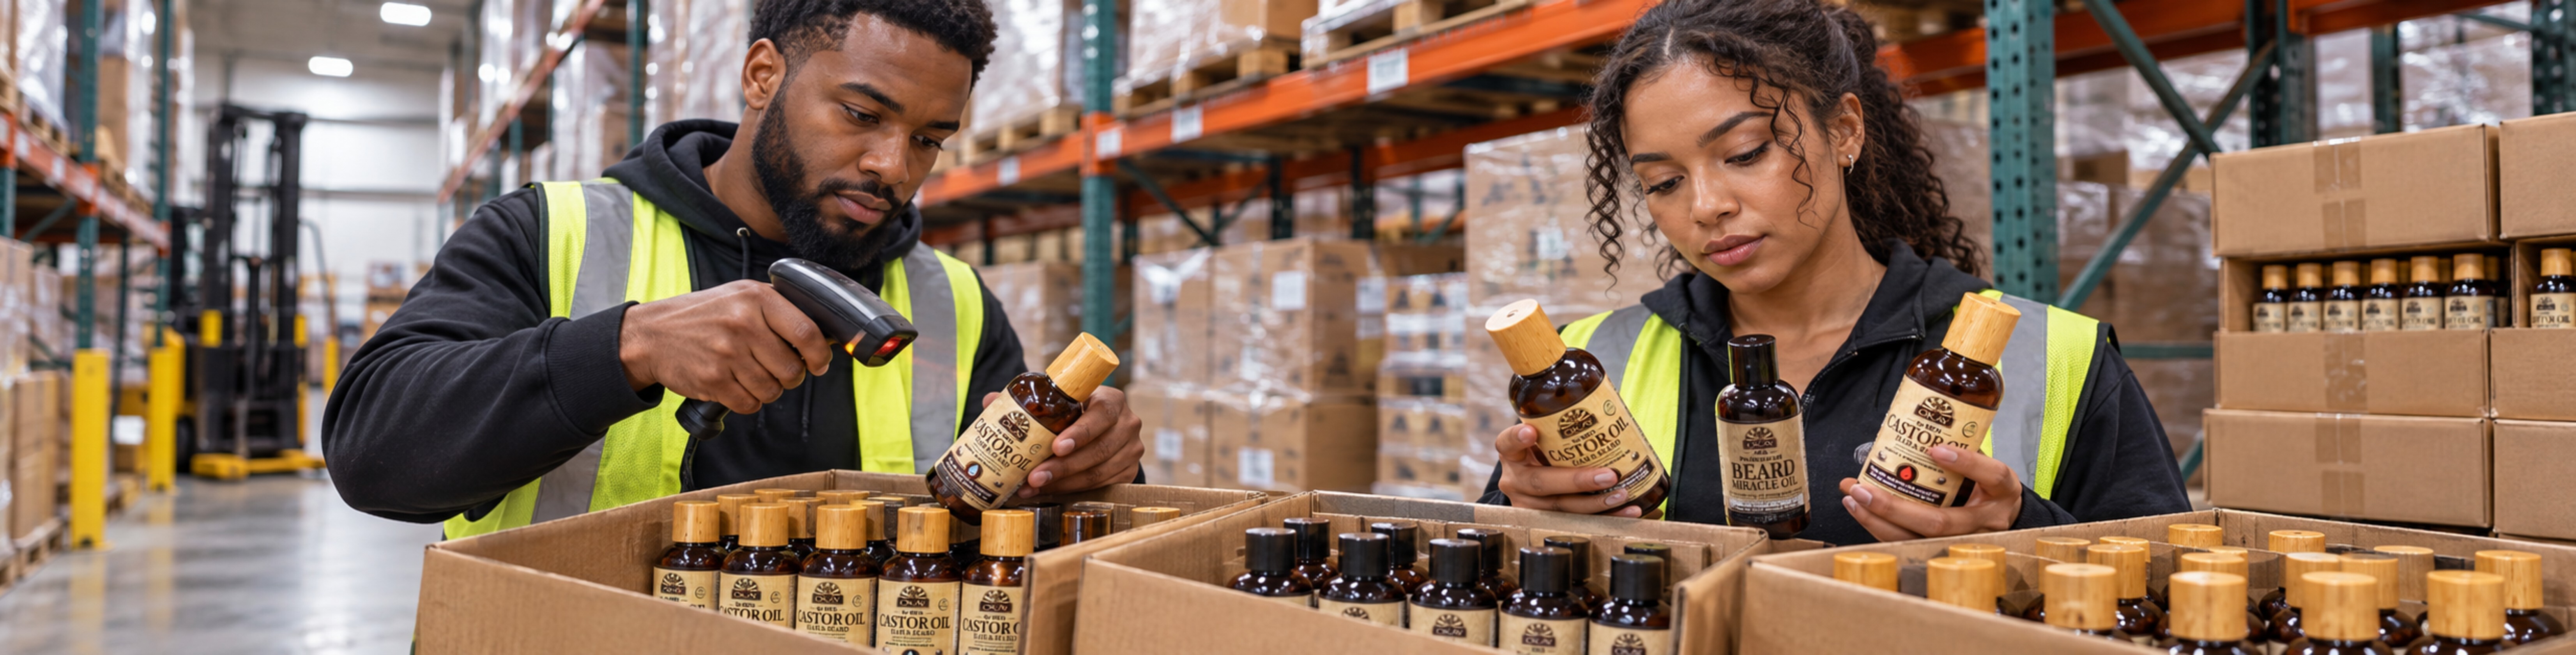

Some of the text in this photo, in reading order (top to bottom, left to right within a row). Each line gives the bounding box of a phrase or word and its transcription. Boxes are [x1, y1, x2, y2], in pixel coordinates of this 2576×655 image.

[1549, 432, 1612, 461] CASTOR
[1608, 416, 1629, 438] OIL
[1887, 414, 1944, 448] CASTOR
[974, 418, 1013, 458] CASTOR
[1010, 454, 1032, 471] OIL
[1731, 459, 1795, 480] BEARD
[1732, 476, 1798, 491] MIRACLE OIL
[762, 609, 784, 622] OIL
[798, 610, 865, 626] CASTOR OIL
[880, 614, 950, 629] CASTOR OIL
[963, 618, 1010, 634] CASTOR
